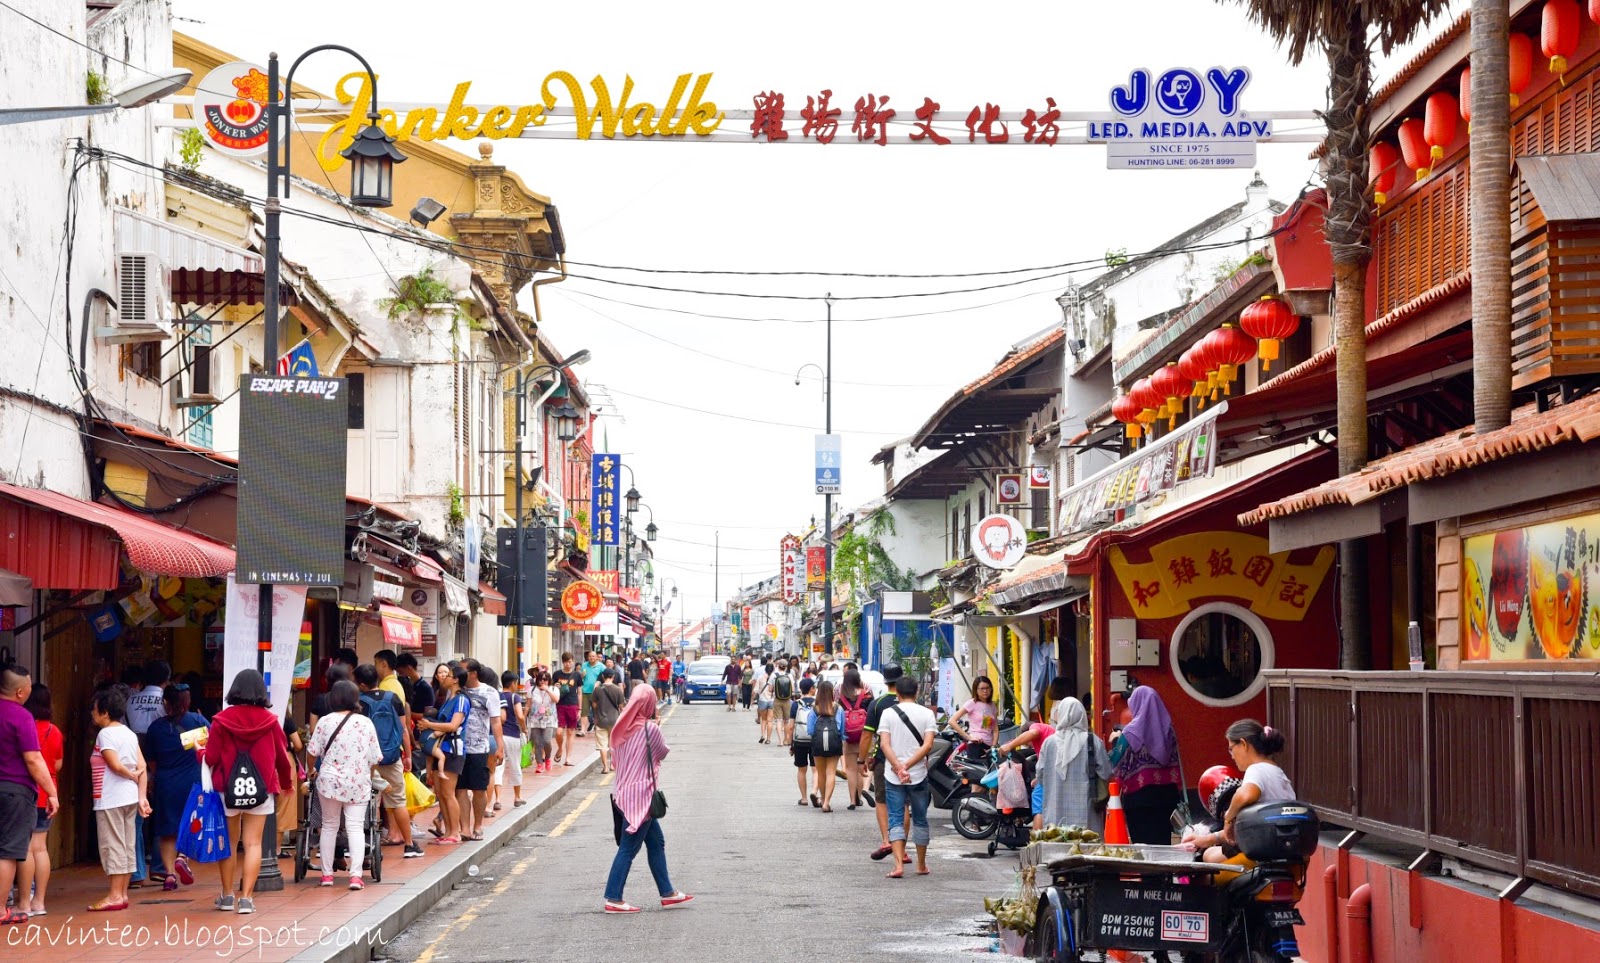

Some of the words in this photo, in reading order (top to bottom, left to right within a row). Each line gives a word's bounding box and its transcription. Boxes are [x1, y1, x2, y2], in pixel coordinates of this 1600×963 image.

[1110, 67, 1248, 118] JOY
[208, 110, 247, 138] JONKER
[316, 70, 547, 171] Jonker
[541, 69, 726, 141] Walk
[1089, 121, 1134, 139] LED.
[1140, 121, 1217, 138] MEDIA.
[1220, 120, 1271, 138] ADV.
[1149, 144, 1185, 154] SINCE
[1186, 143, 1210, 153] 1975
[1127, 158, 1165, 167] HUNTING
[1166, 158, 1187, 167] LINE:
[1188, 158, 1214, 166] 06-281
[1216, 157, 1235, 166] 8999
[249, 377, 296, 393] ESCAPE
[248, 571, 257, 581] IN
[261, 571, 300, 582] CINEMAS
[316, 573, 332, 583] JUL
[784, 543, 795, 598] MAMEE
[130, 694, 164, 706] TIGER
[233, 776, 258, 796] 88
[234, 797, 257, 807] EXO
[1124, 888, 1140, 900] TAN
[1143, 890, 1162, 901] KHEE
[1164, 891, 1183, 902] LIAN
[1101, 913, 1122, 925] BDM
[1165, 915, 1180, 929] 60
[1273, 911, 1294, 921] MAT
[1100, 925, 1121, 936] BTM
[1186, 920, 1201, 931] 70
